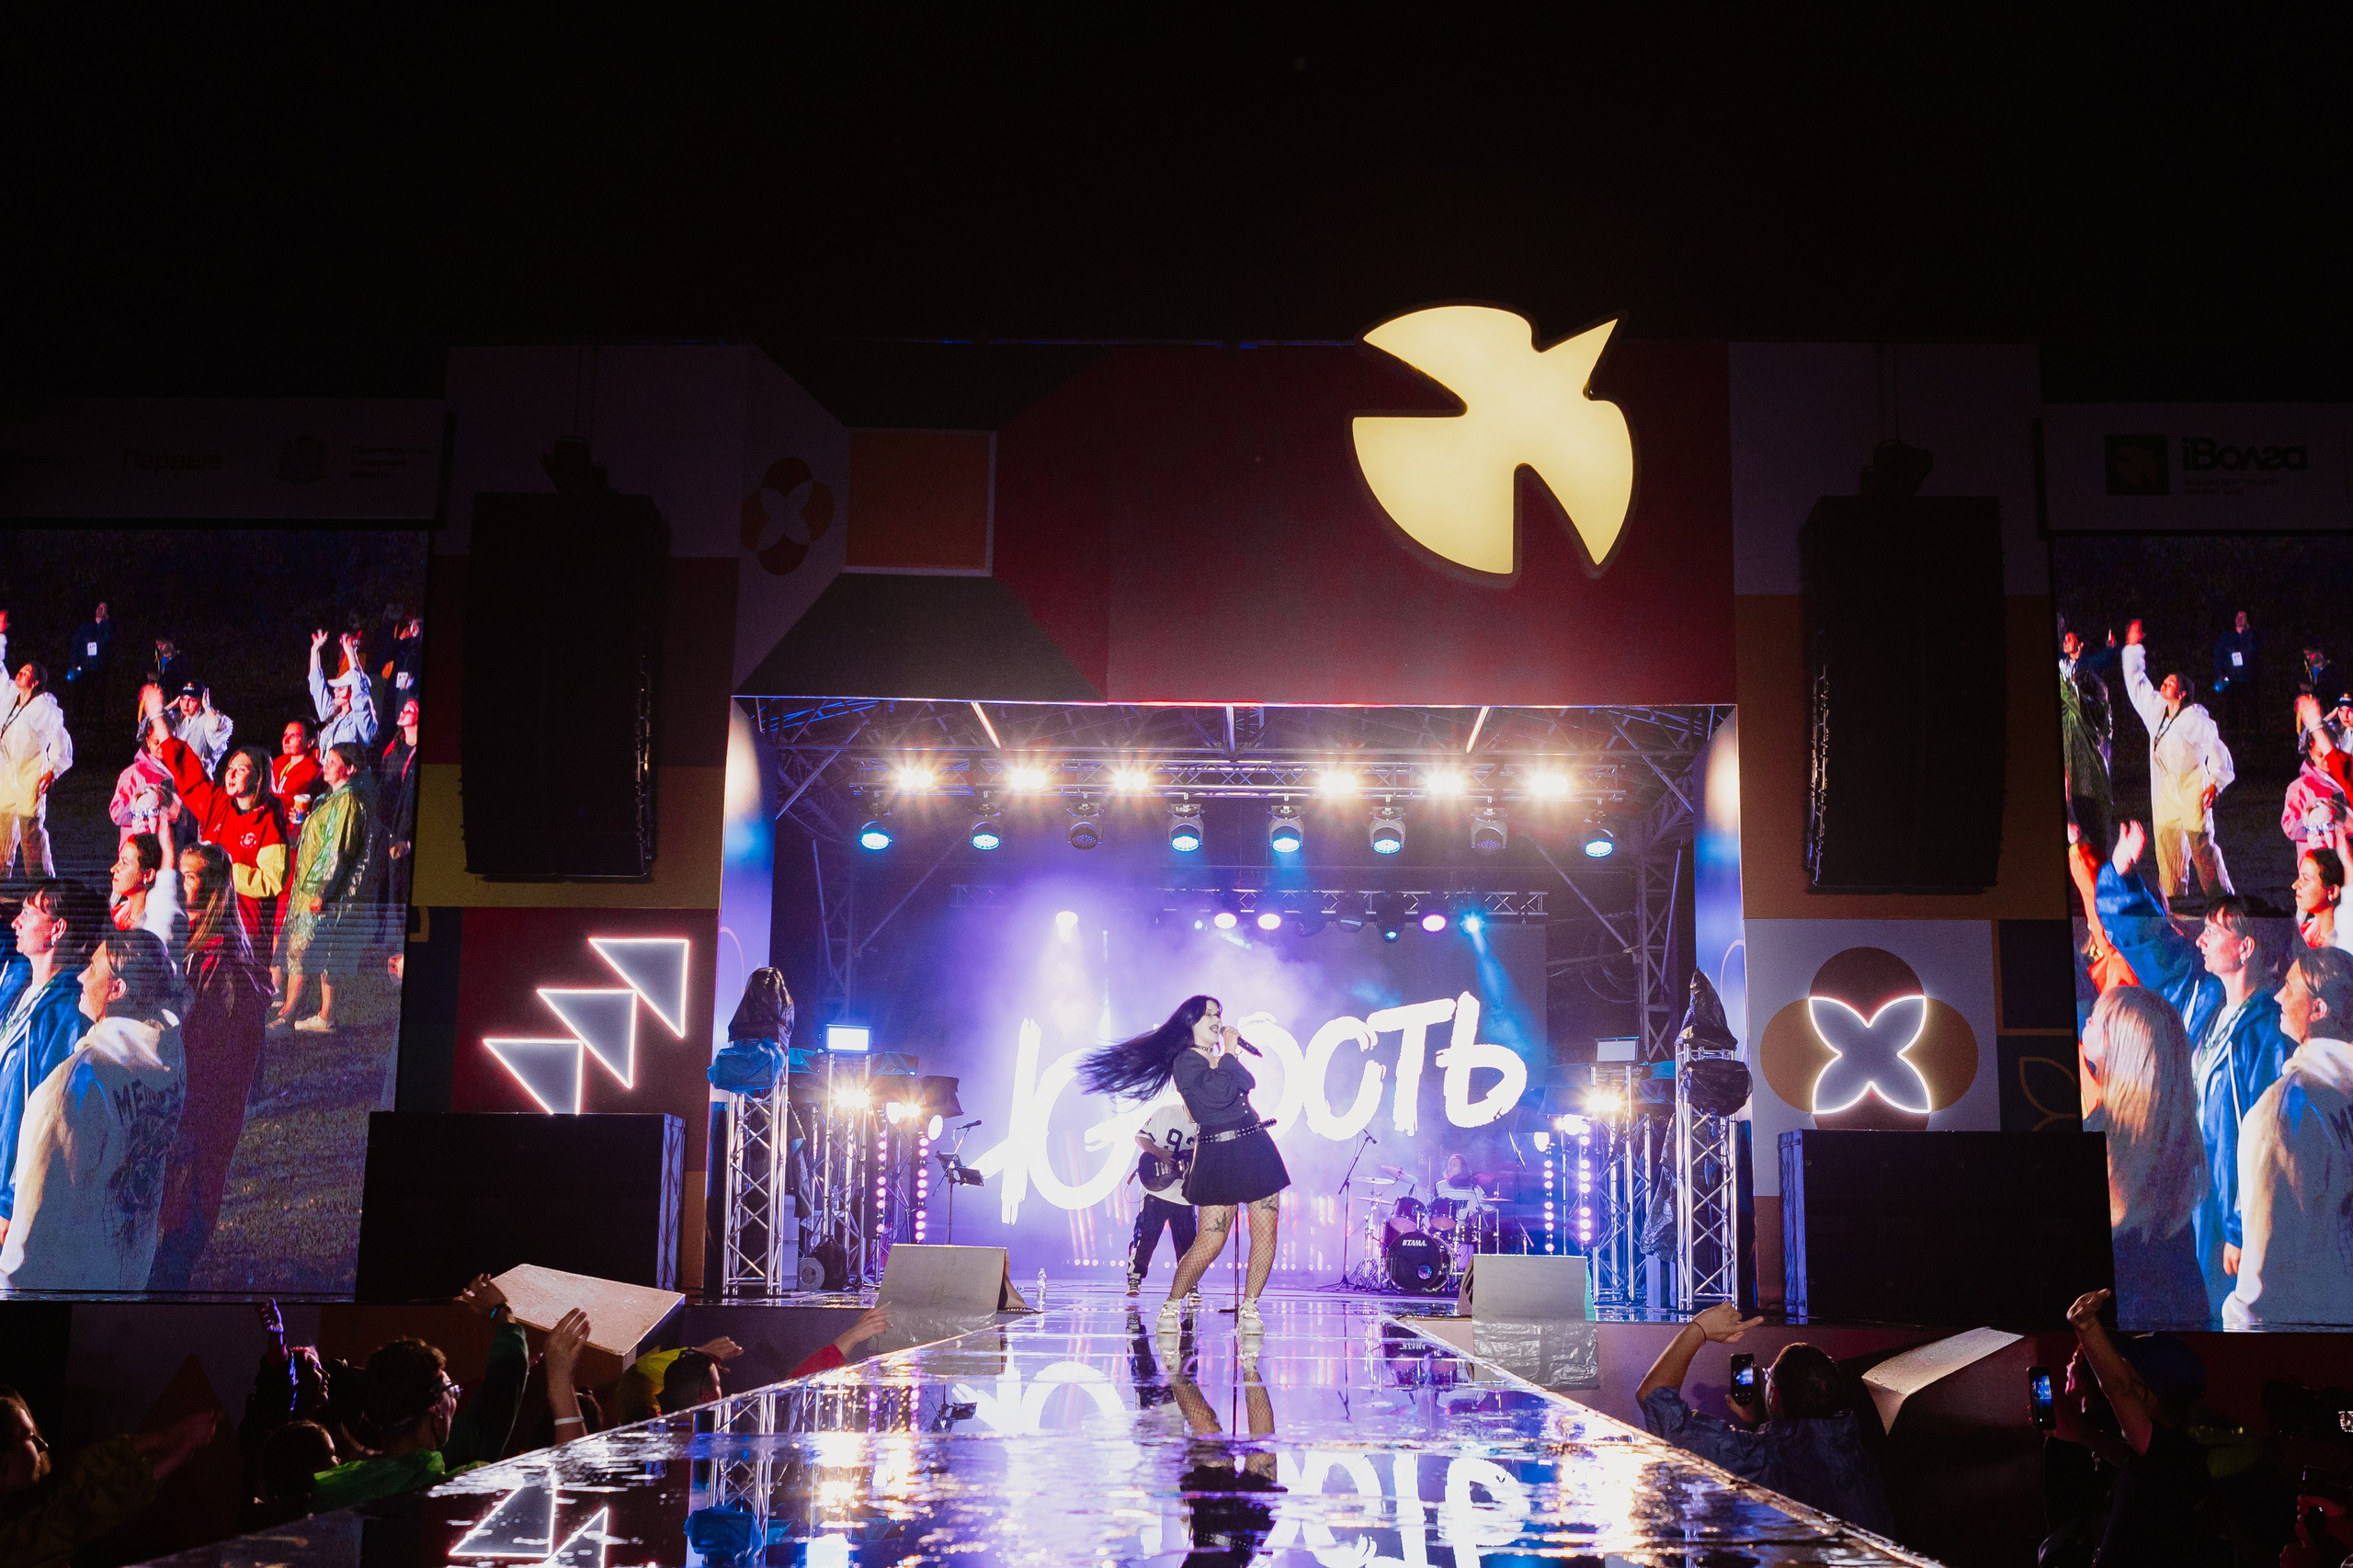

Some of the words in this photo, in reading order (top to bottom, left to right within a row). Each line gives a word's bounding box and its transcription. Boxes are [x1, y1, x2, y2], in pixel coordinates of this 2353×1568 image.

[121, 449, 222, 476] Первые
[967, 991, 1528, 1224] ЮОСТЬ
[1404, 1239, 1427, 1247] TAMA
